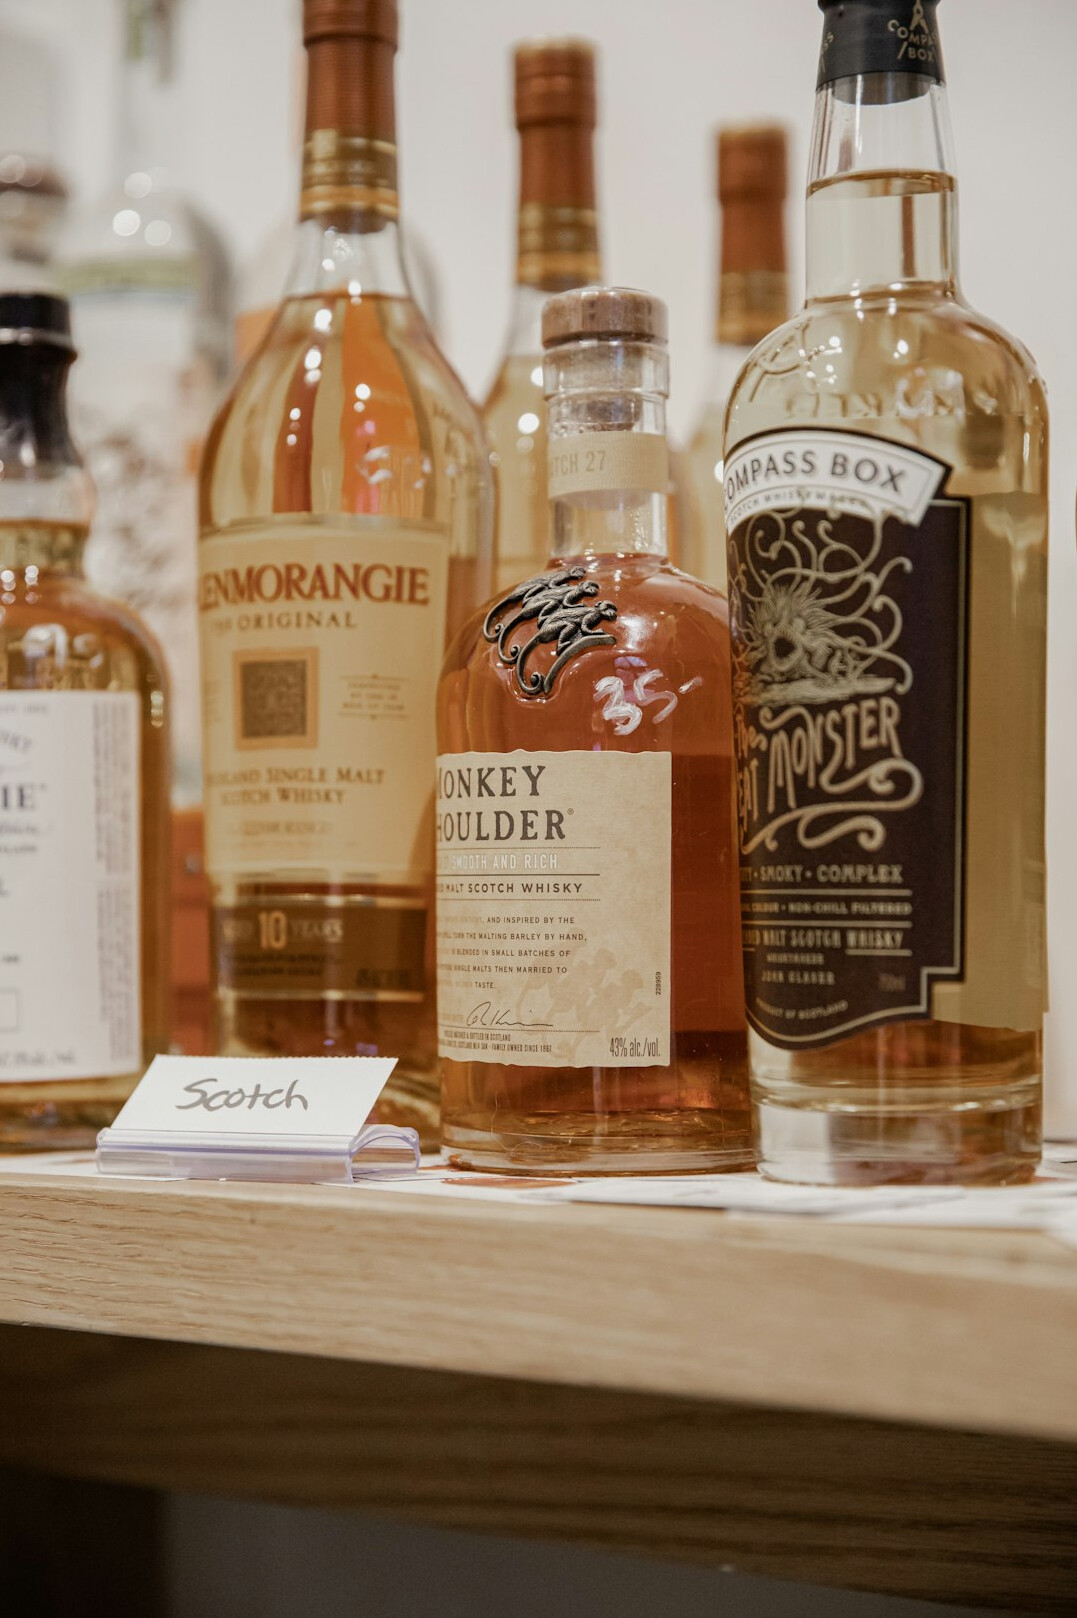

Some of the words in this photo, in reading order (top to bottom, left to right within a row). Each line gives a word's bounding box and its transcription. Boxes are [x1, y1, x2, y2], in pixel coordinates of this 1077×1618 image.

[585, 449, 606, 472] 27
[726, 450, 816, 502] OMPASS
[831, 452, 905, 492] BOX
[237, 611, 358, 630] ORIGINAL
[766, 696, 905, 813] MONSTER
[337, 766, 385, 784] MALT
[438, 765, 546, 799] ONKEY
[277, 787, 343, 803] WHISKY
[452, 854, 487, 870] SMOOTH
[493, 854, 516, 870] AND
[524, 854, 557, 870] RICH
[759, 864, 803, 882] SMOKY
[816, 864, 904, 884] COMPLEX
[446, 882, 464, 893] MALT
[468, 883, 514, 893] SCOTCH
[521, 883, 582, 893] WHISKY
[486, 916, 501, 924] AND
[503, 916, 540, 924] INSPIRED
[543, 916, 554, 924] BY
[558, 916, 575, 924] THE
[258, 909, 287, 950] 10
[559, 934, 587, 942] HAND,
[789, 929, 841, 948] SCOTCH
[846, 929, 904, 949] WHISKY
[491, 949, 515, 957] SMALL
[518, 949, 555, 957] BATCHES
[472, 965, 492, 973] MALTS
[494, 965, 513, 973] THEN
[516, 966, 553, 974] MARRIED
[474, 981, 496, 989] TASTE.
[490, 1033, 511, 1041] SCOTLAND
[491, 1043, 506, 1051] FAMILY
[507, 1044, 523, 1052] OWNED
[524, 1044, 538, 1052] SINCE
[609, 1037, 628, 1057] 43%
[629, 1037, 661, 1057] alc./vol.
[176, 1078, 308, 1112] Scotch
